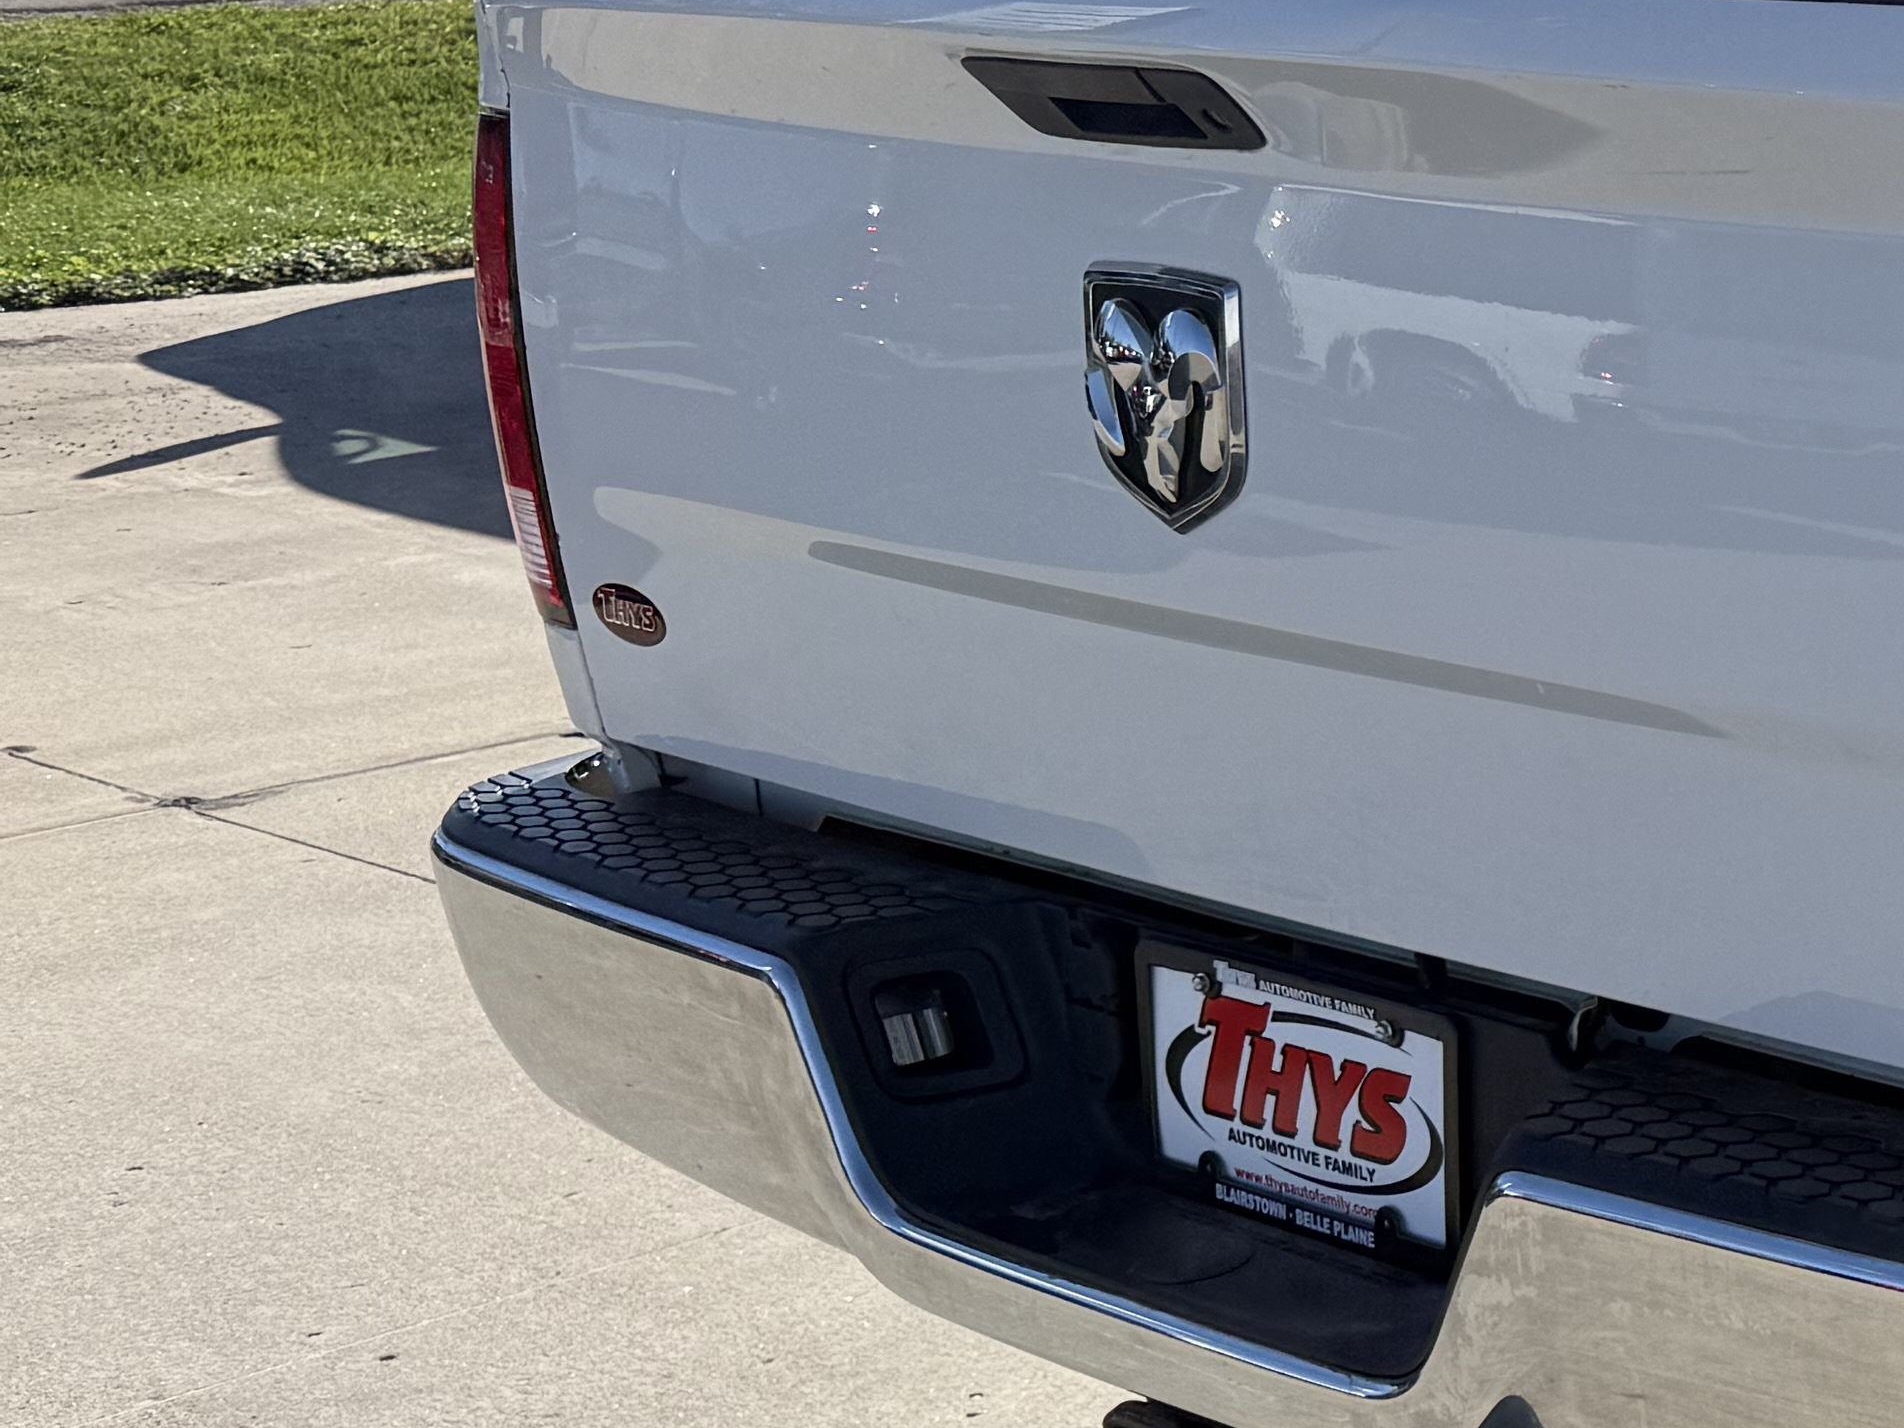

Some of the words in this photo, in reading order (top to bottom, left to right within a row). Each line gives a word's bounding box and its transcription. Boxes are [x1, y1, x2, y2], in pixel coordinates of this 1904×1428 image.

[597, 586, 656, 633] THYS
[1259, 980, 1333, 1009] AUTOMOTIVE
[1334, 999, 1375, 1020] FAMILY
[1195, 996, 1413, 1166] THYS
[1228, 1127, 1321, 1168] AUTOMOTIVE
[1324, 1155, 1376, 1184] FAMILY
[1215, 1183, 1287, 1221] BLAIRSTOWN
[1295, 1208, 1331, 1234] BELLE
[1334, 1220, 1376, 1248] PLAINE
